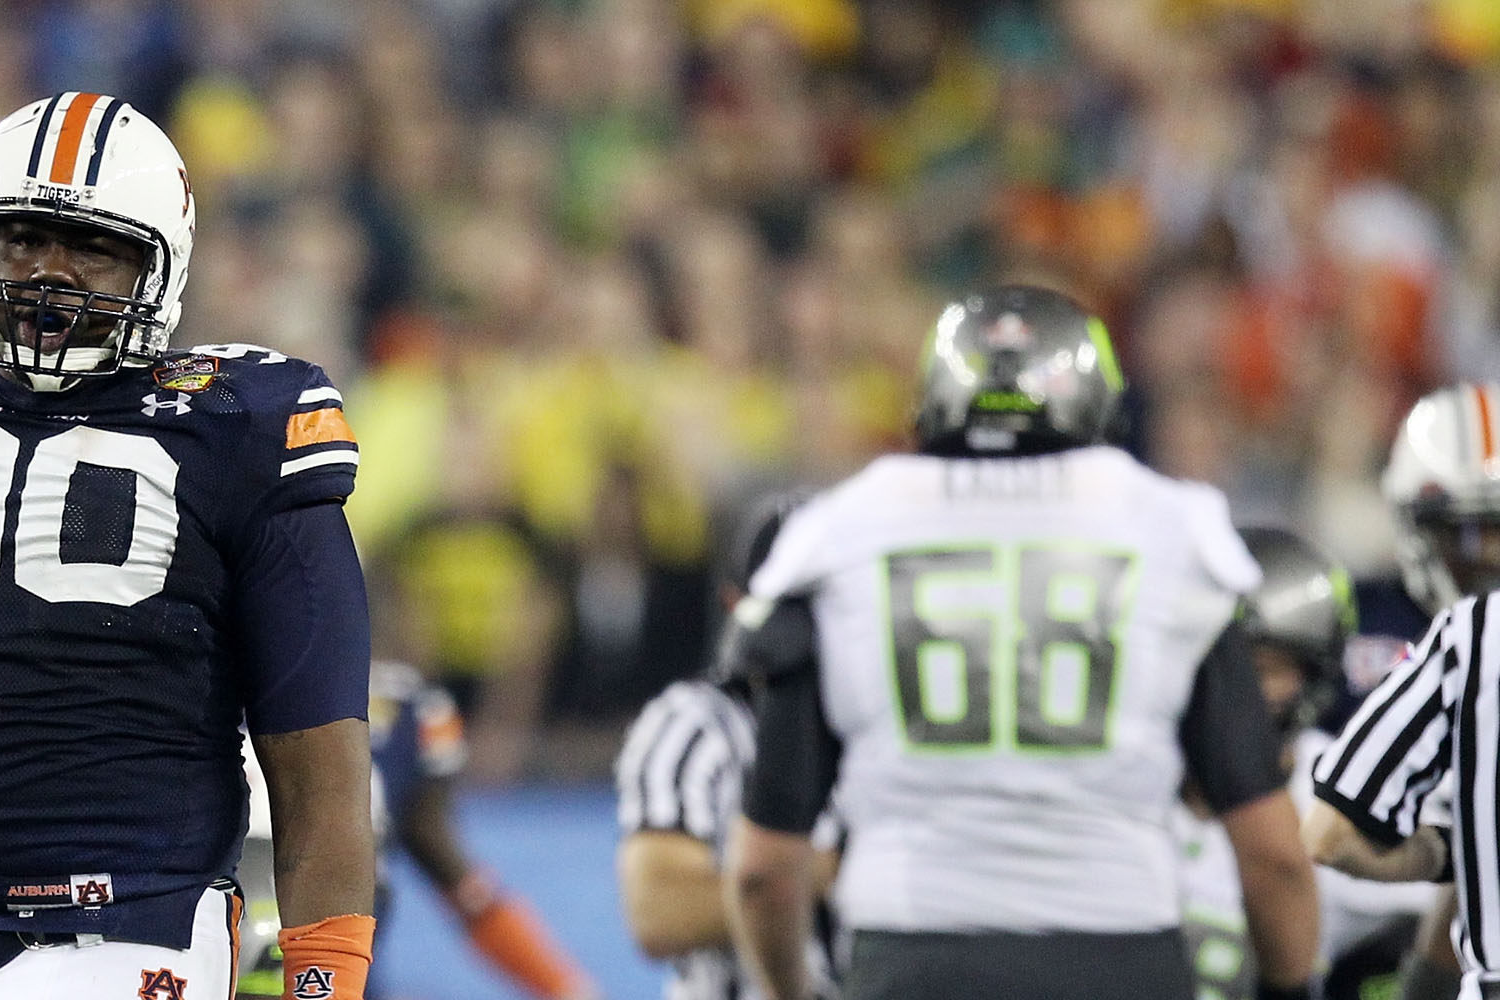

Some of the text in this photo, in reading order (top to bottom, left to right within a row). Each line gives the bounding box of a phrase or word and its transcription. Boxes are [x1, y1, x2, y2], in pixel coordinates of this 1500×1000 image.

[37, 184, 80, 202] TIGERS
[877, 542, 1141, 755] 68
[7, 884, 70, 896] AUBURN
